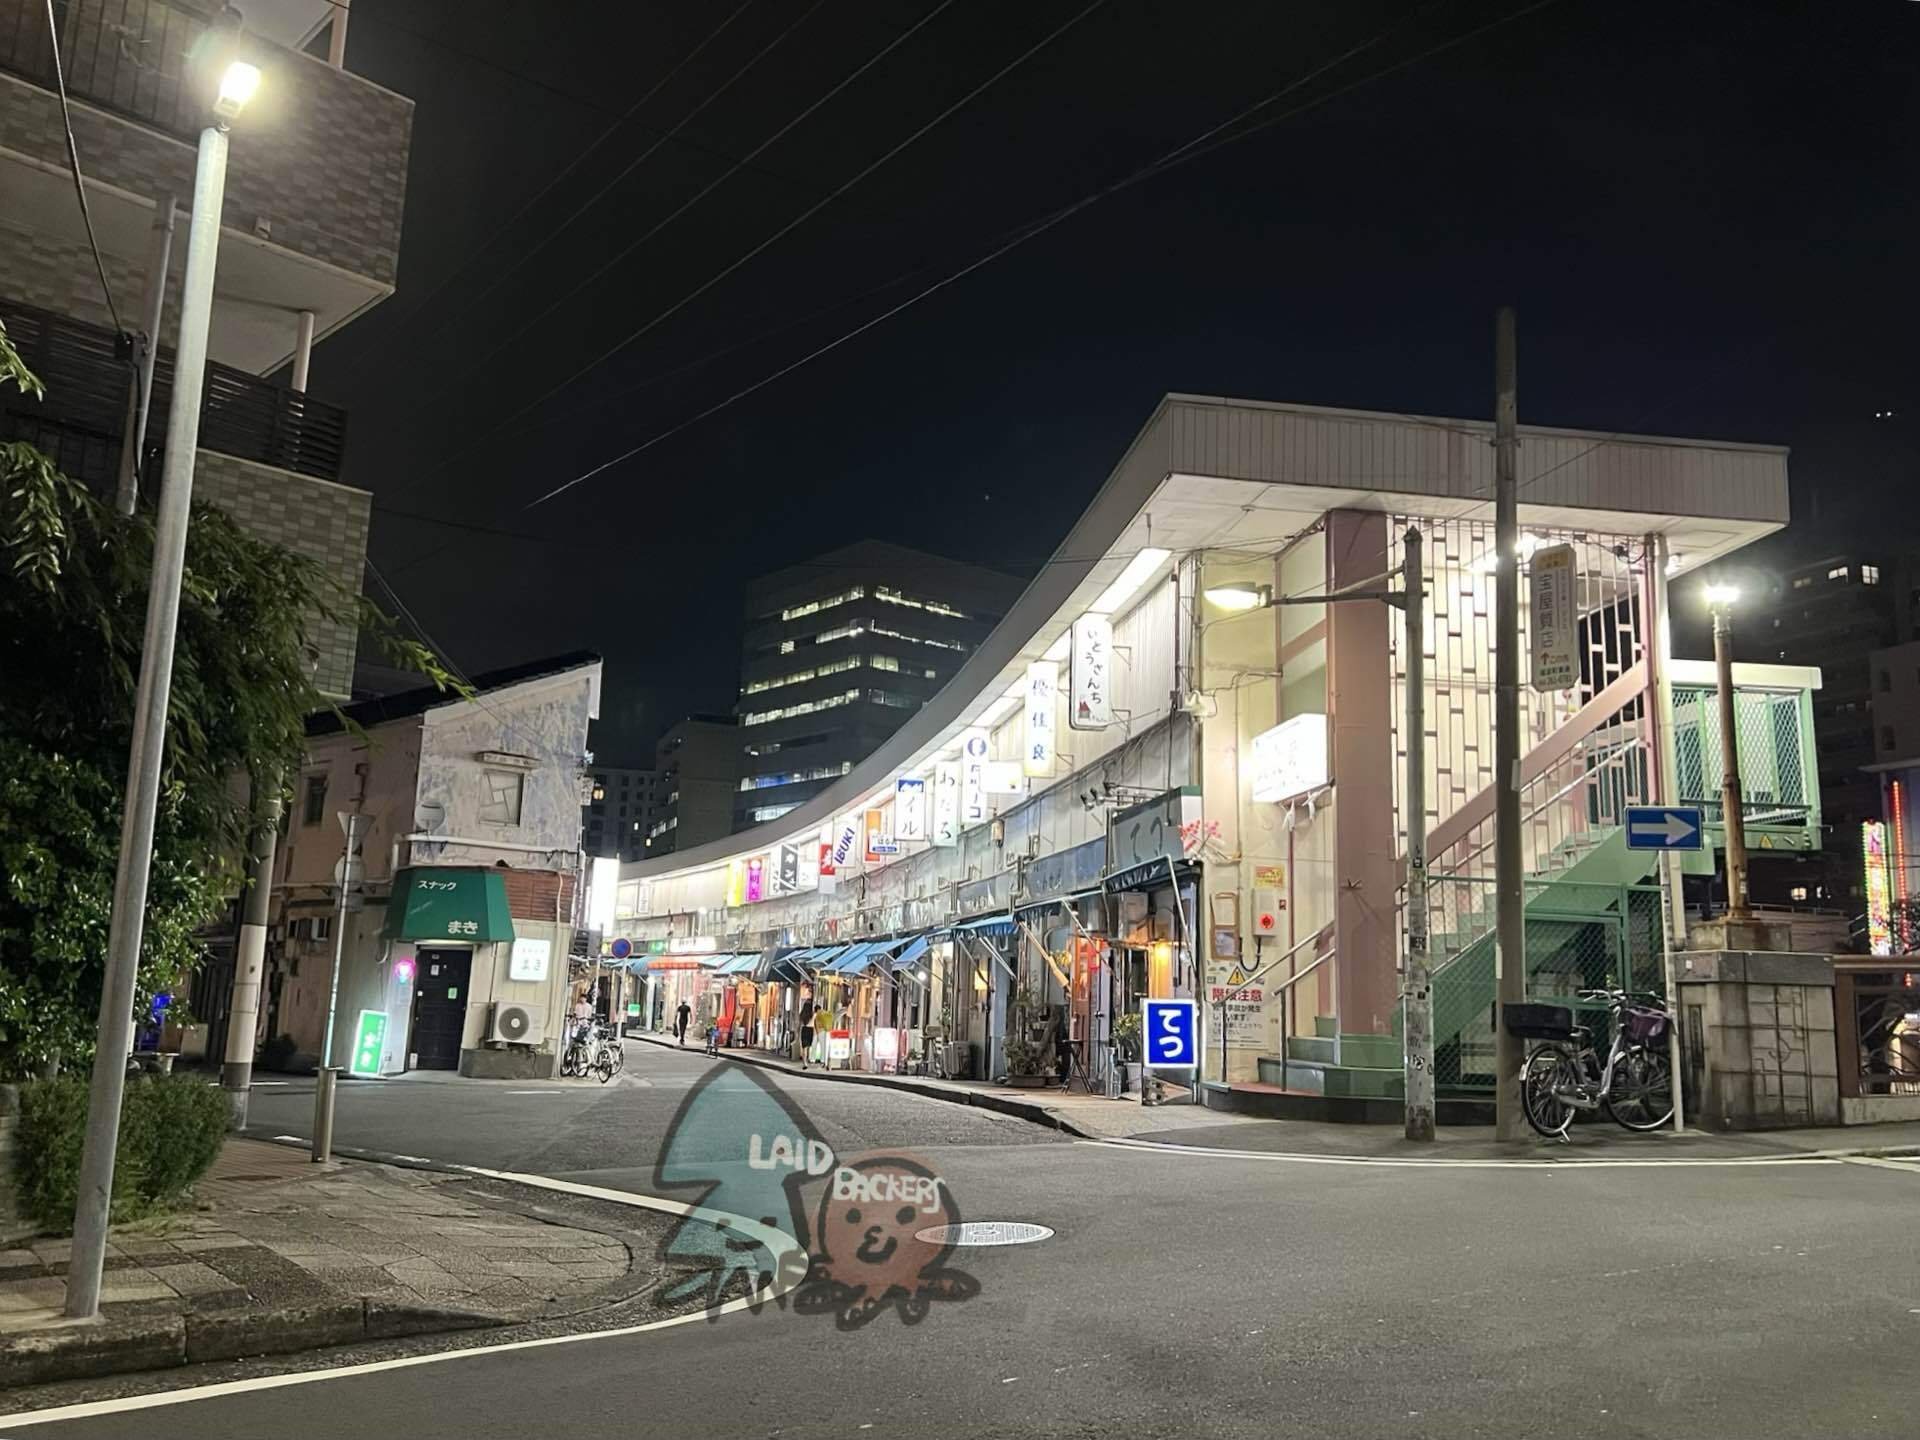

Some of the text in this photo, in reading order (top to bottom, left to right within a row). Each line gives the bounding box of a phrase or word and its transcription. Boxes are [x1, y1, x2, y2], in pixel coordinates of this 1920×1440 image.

[1084, 629, 1103, 705] いとうさんち
[834, 827, 856, 865] IBUKI
[417, 880, 457, 891] スナック
[447, 920, 479, 935] まき
[1159, 1009, 1183, 1058] てつ
